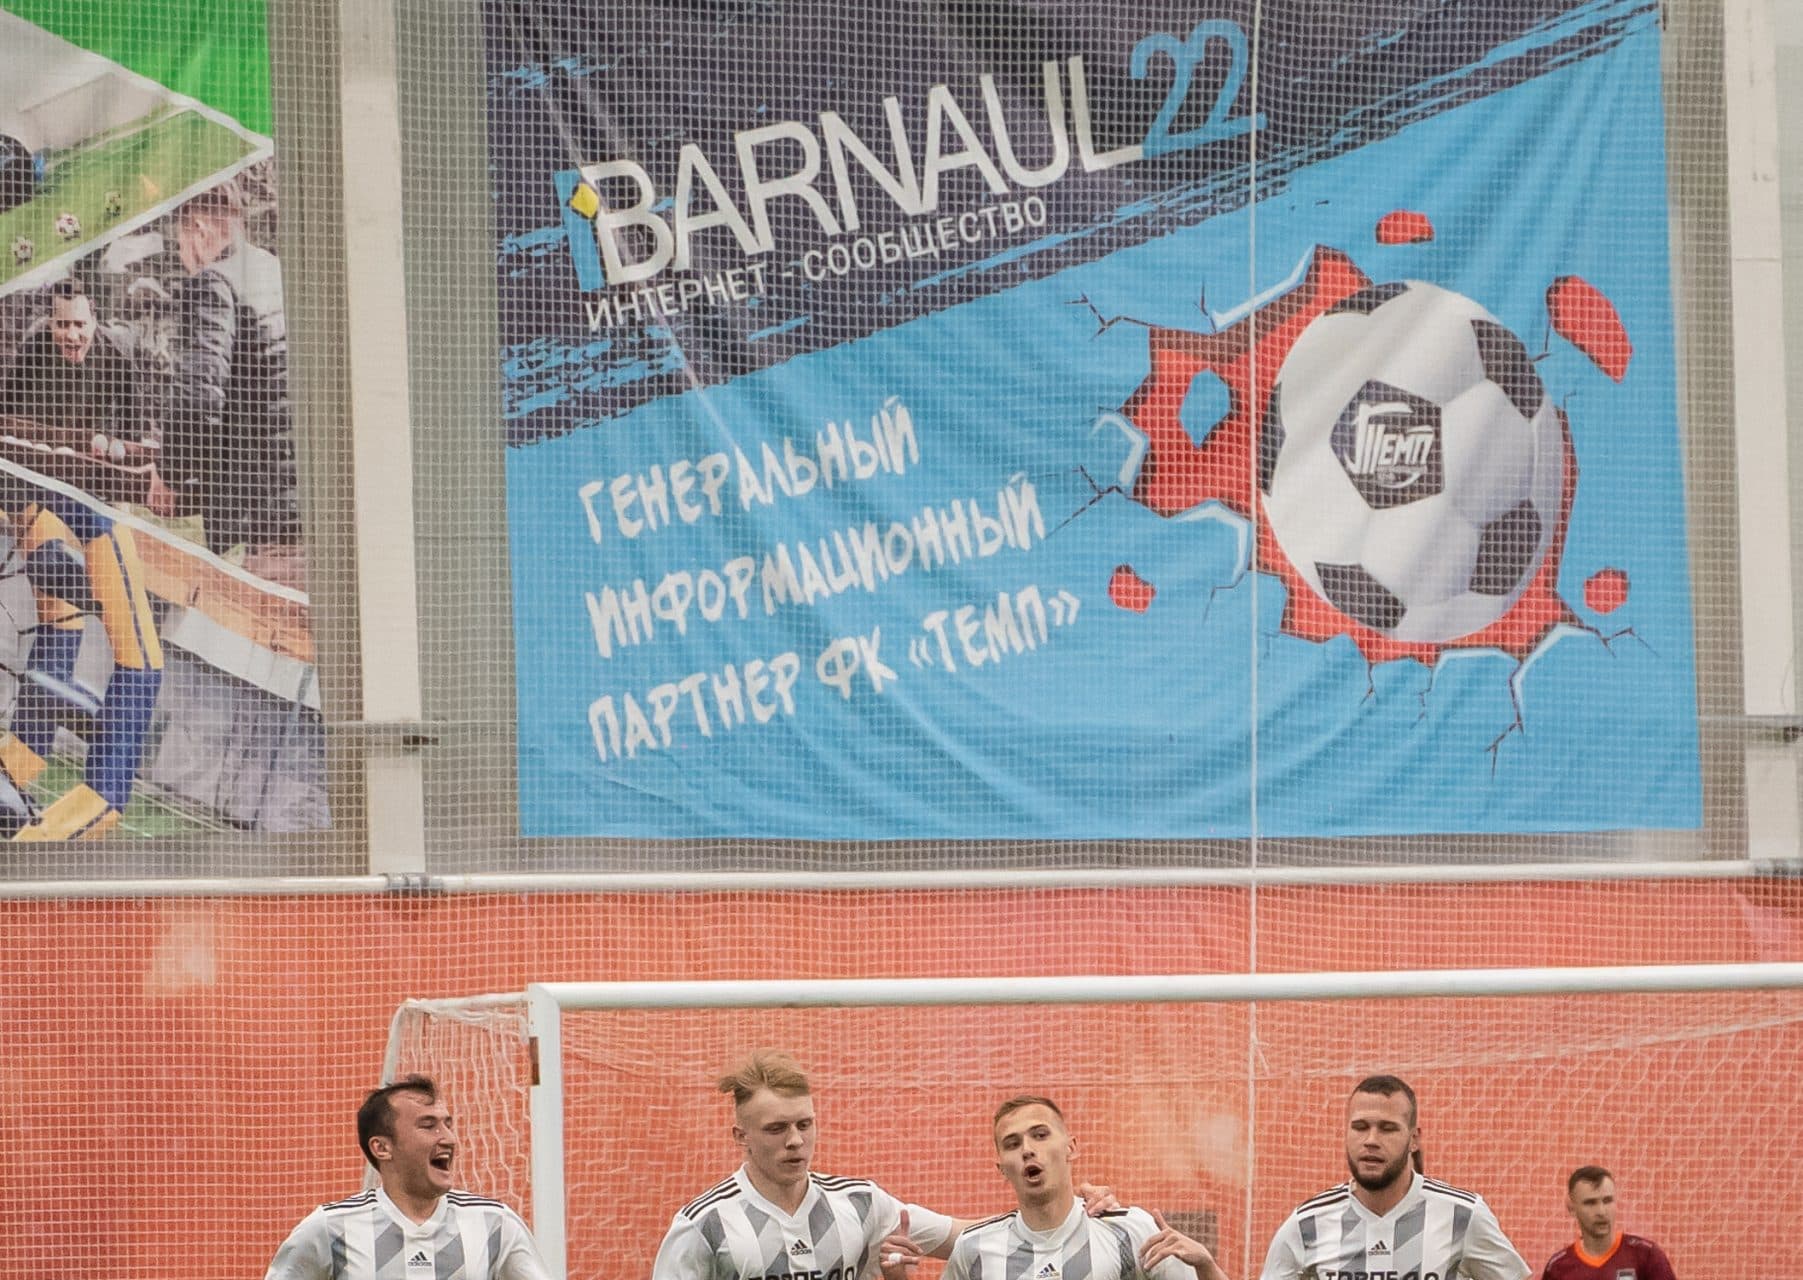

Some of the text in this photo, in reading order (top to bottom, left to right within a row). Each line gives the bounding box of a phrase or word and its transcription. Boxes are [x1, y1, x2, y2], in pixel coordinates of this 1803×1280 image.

[585, 262, 767, 332] ИНТЕРНЕТ
[578, 395, 919, 543] ГЕНЕРАЛЬНЫЙ
[585, 471, 1045, 658] ИНФОРМАЦИОННЫЙ
[588, 585, 1081, 762] ПАРТНЕР ФК «ТЕМП»
